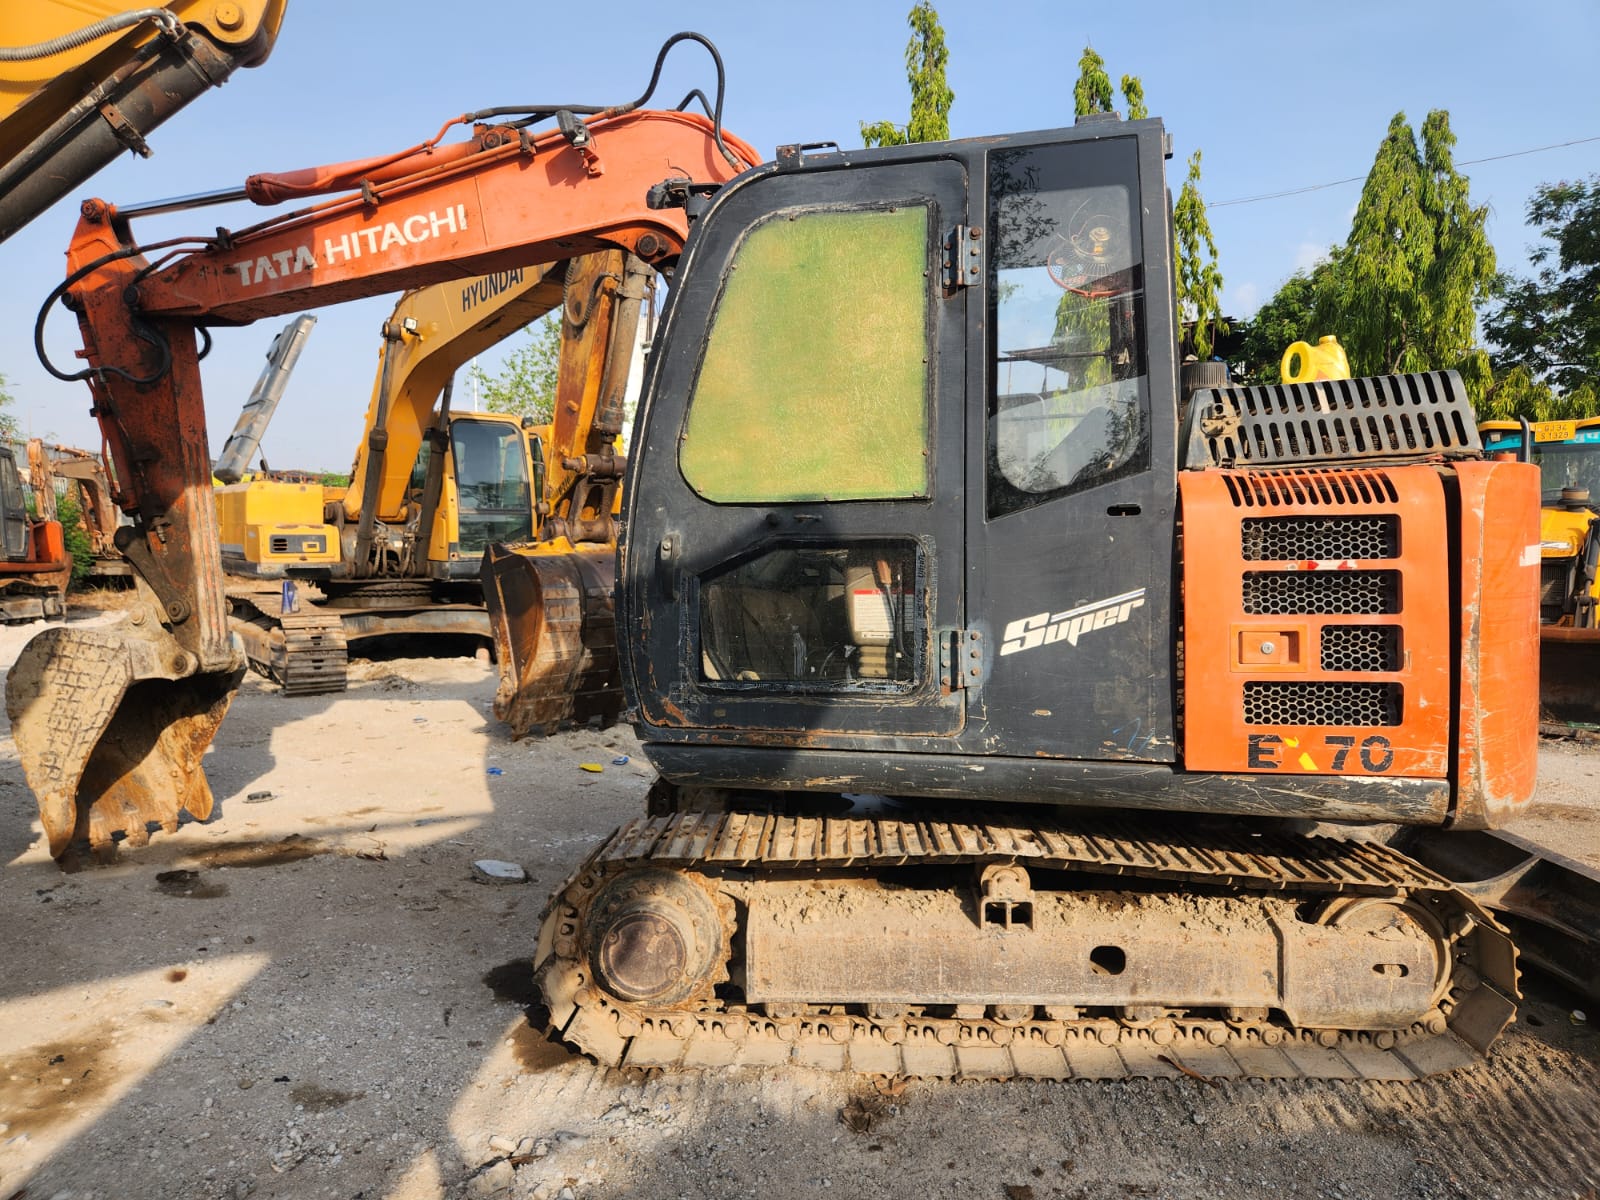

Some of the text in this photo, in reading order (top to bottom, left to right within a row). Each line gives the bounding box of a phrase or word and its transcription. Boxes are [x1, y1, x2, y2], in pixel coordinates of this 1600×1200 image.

[234, 204, 467, 286] TATA HITACHI
[462, 267, 524, 312] HYUNDAI
[1000, 596, 1145, 656] Super
[1325, 735, 1394, 773] 70
